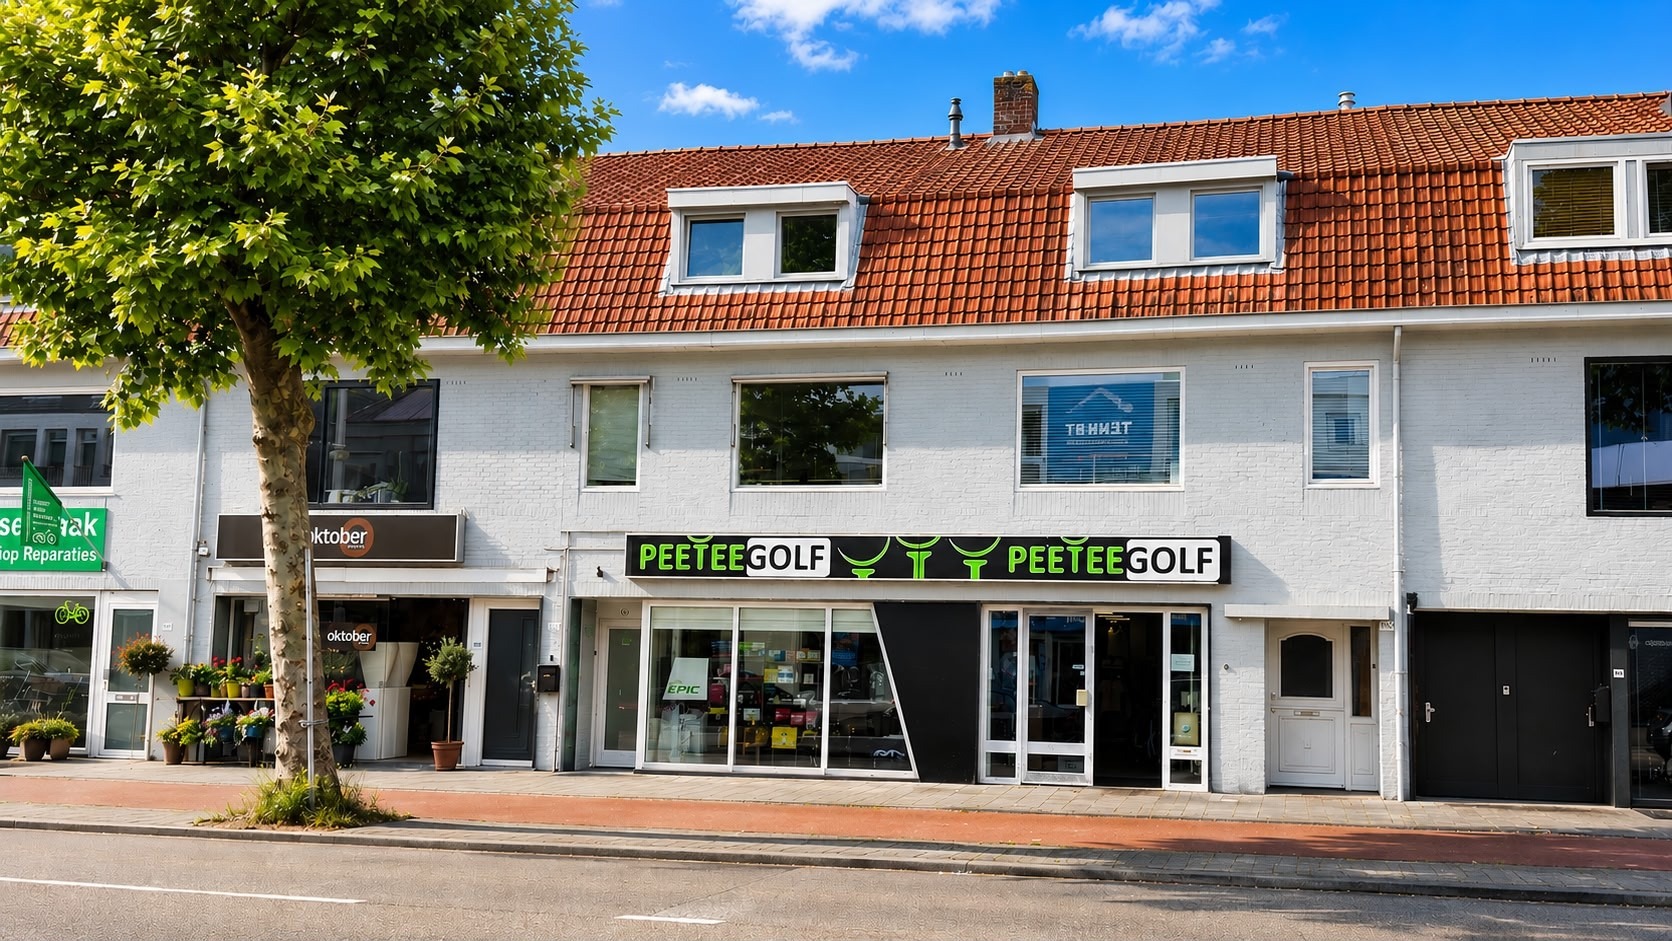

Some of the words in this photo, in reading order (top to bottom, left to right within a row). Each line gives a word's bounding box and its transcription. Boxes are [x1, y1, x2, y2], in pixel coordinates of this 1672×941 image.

[311, 526, 368, 545] ktober
[23, 546, 97, 565] Reparaties
[327, 630, 372, 642] oktober
[667, 685, 700, 694] EPIC
